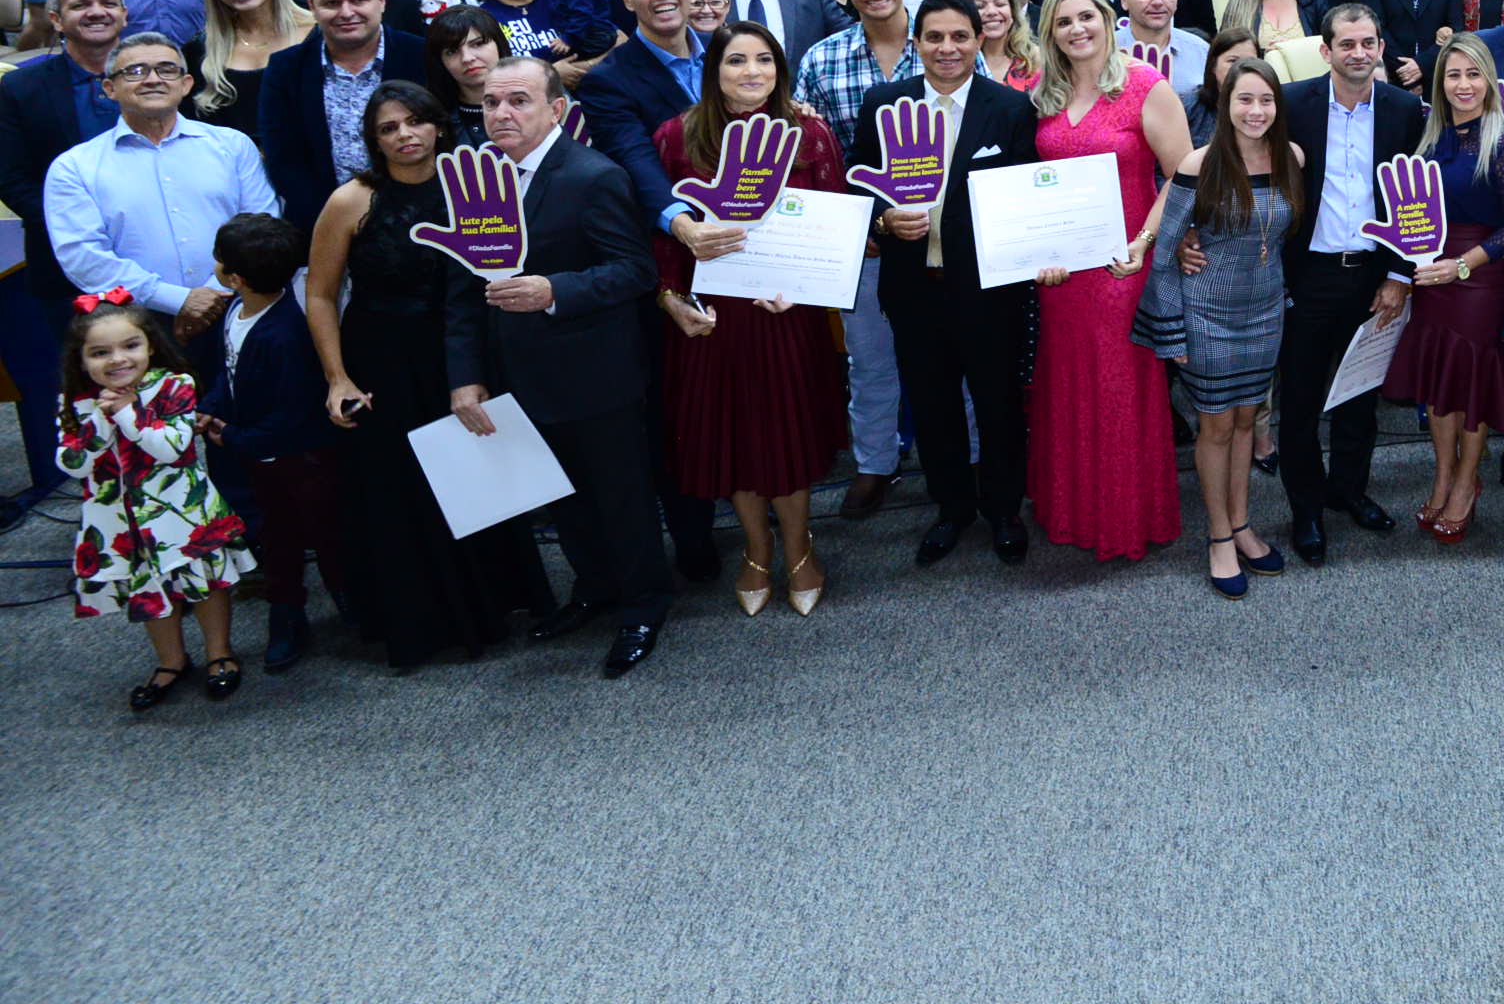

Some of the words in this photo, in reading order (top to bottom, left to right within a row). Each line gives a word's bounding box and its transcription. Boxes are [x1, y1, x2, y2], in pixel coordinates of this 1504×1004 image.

[1404, 202, 1427, 210] minha
[460, 217, 480, 225] Lute
[482, 215, 503, 227] pela
[480, 224, 517, 234] Família!
[1410, 225, 1436, 234] Senhor
